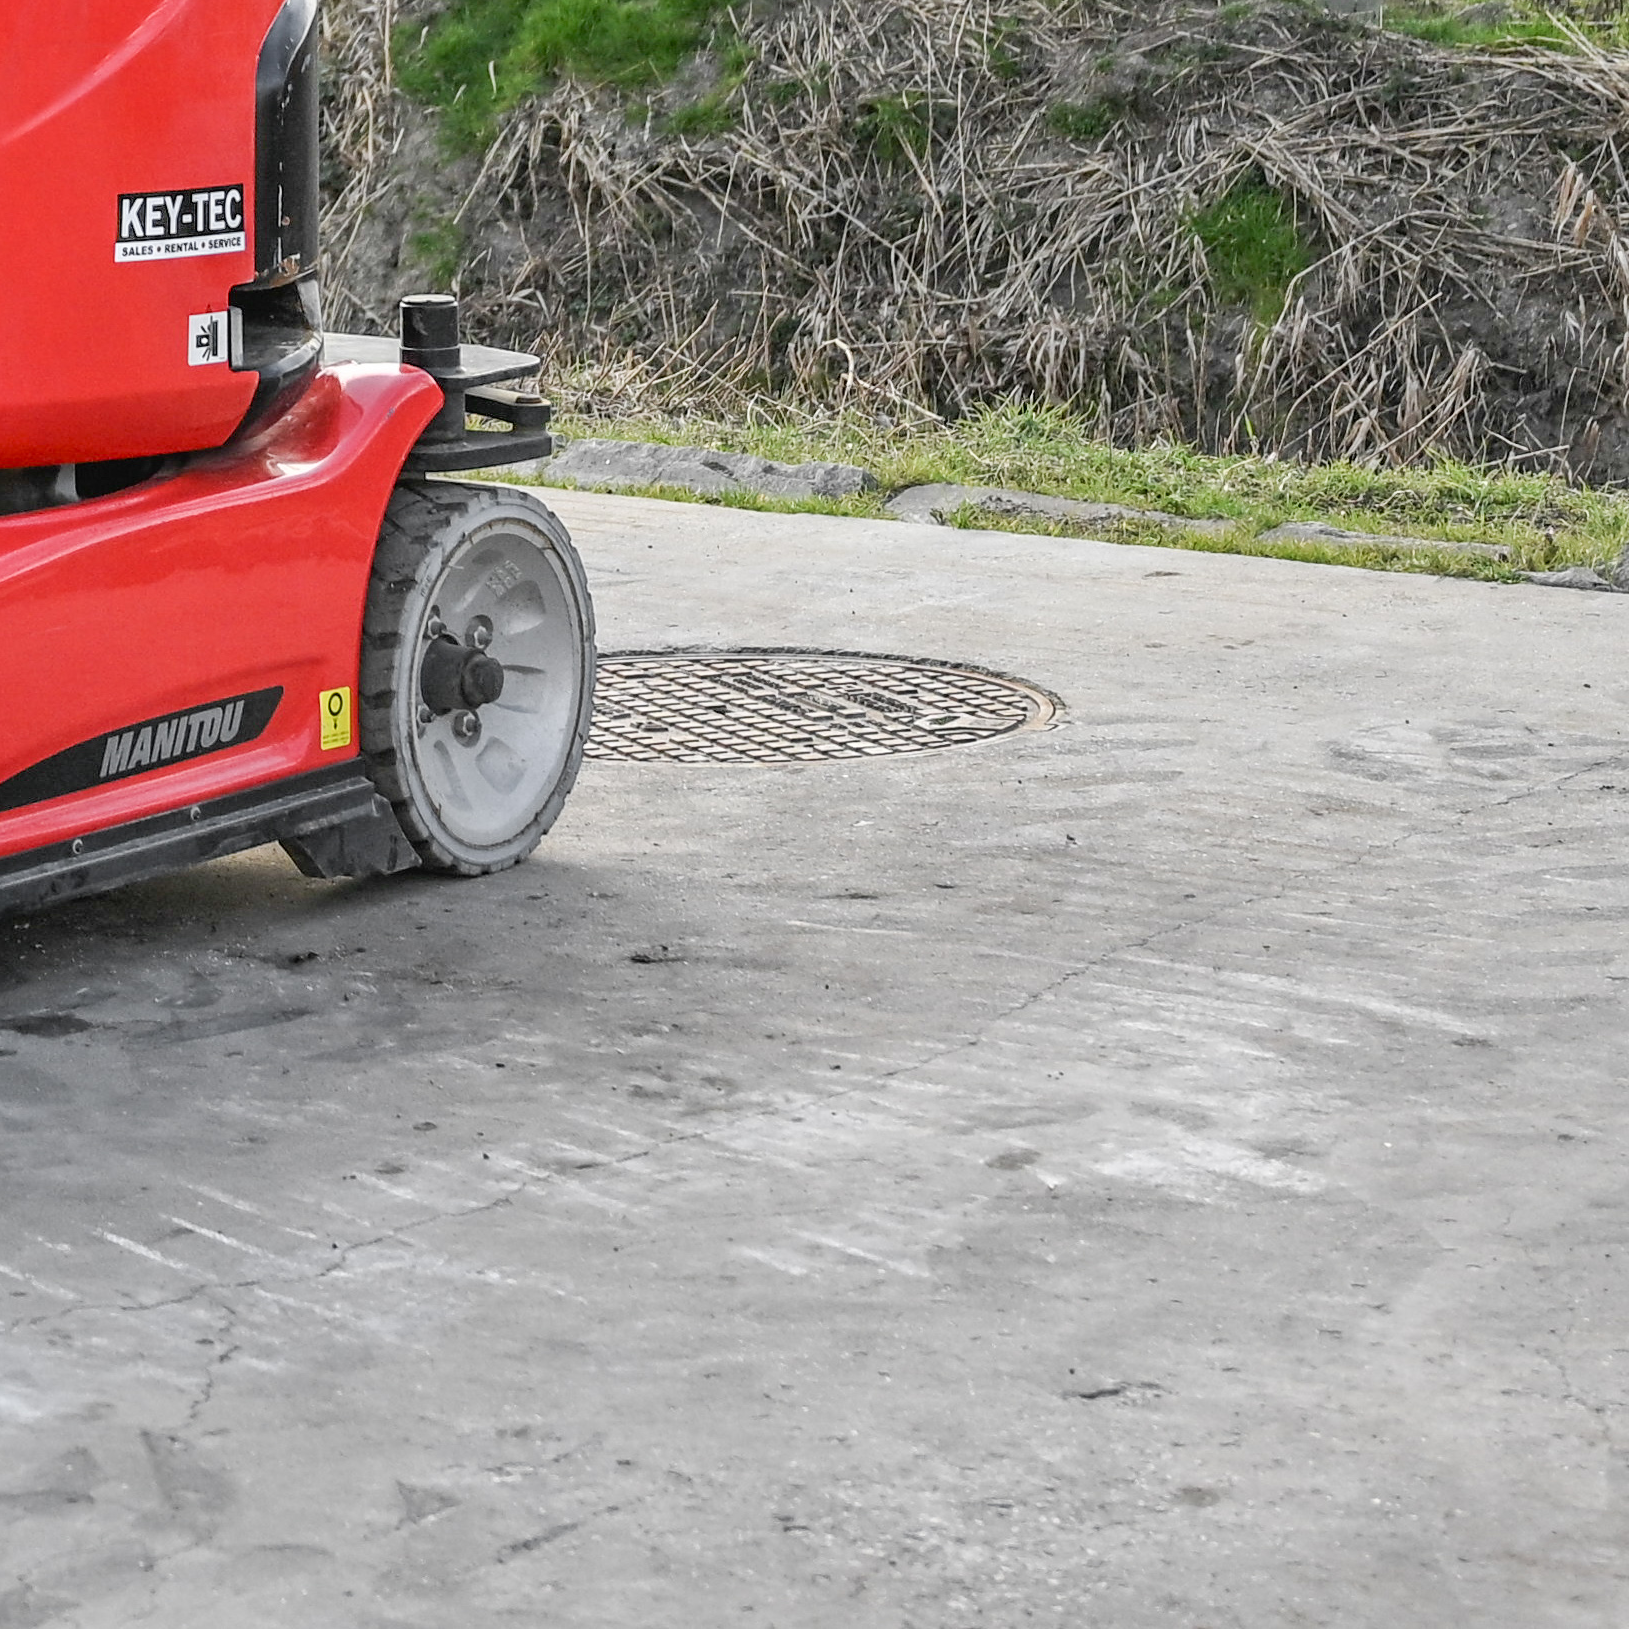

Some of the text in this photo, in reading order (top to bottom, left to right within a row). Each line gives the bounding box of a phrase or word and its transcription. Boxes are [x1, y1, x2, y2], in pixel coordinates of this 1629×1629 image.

[121, 188, 242, 239] KEY-TEC
[122, 237, 241, 257] SALES RENTAL SERVICE
[100, 699, 245, 778] MANITOU
